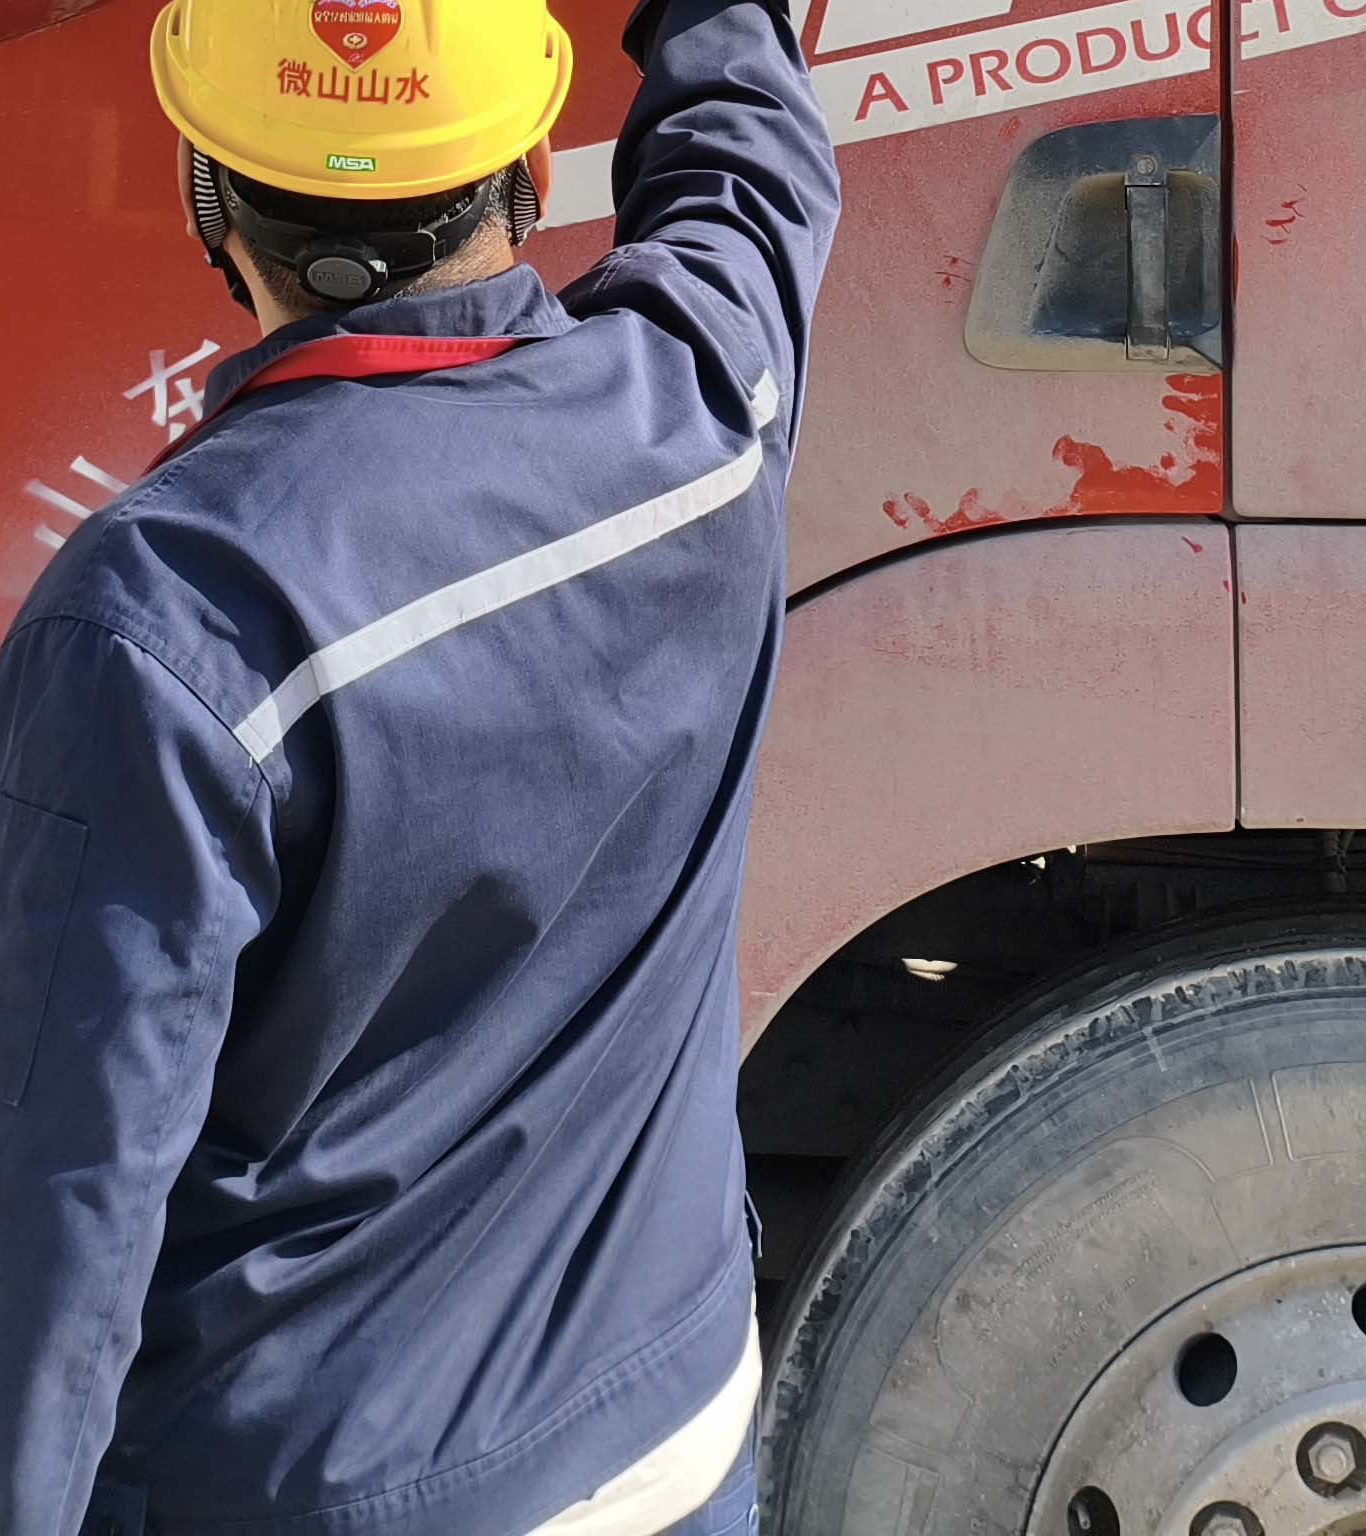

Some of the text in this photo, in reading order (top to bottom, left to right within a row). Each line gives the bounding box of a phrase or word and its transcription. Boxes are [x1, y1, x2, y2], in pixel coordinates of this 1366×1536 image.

[277, 58, 431, 105] 微山山水
[853, 73, 908, 122] A
[328, 155, 375, 171] MSA
